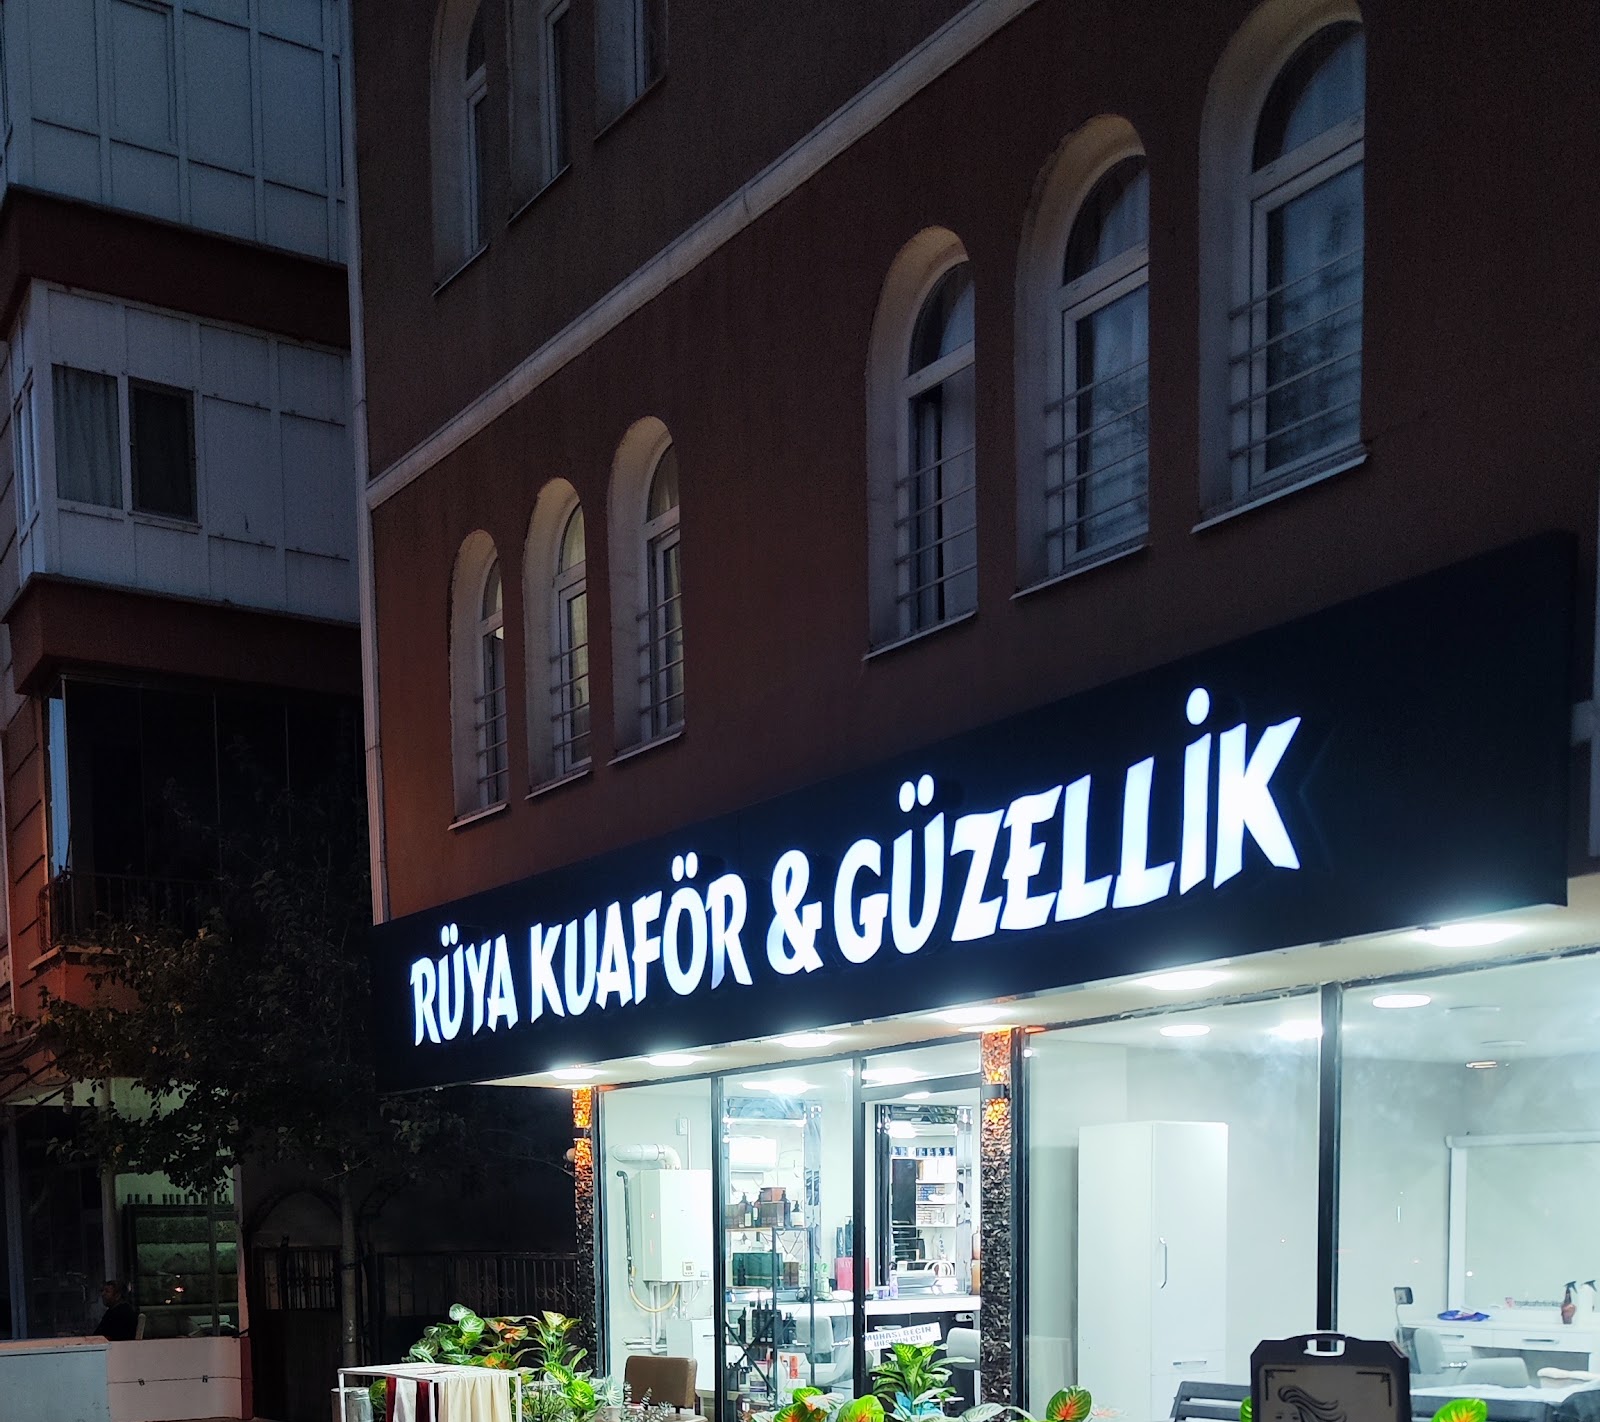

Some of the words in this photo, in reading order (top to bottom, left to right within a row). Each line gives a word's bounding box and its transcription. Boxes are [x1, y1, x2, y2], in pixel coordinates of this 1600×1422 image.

[409, 922, 519, 1047] RÜYA
[530, 851, 753, 1024] KUAFÖR
[766, 849, 827, 975] &
[833, 687, 1301, 964] GÜZELLİK
